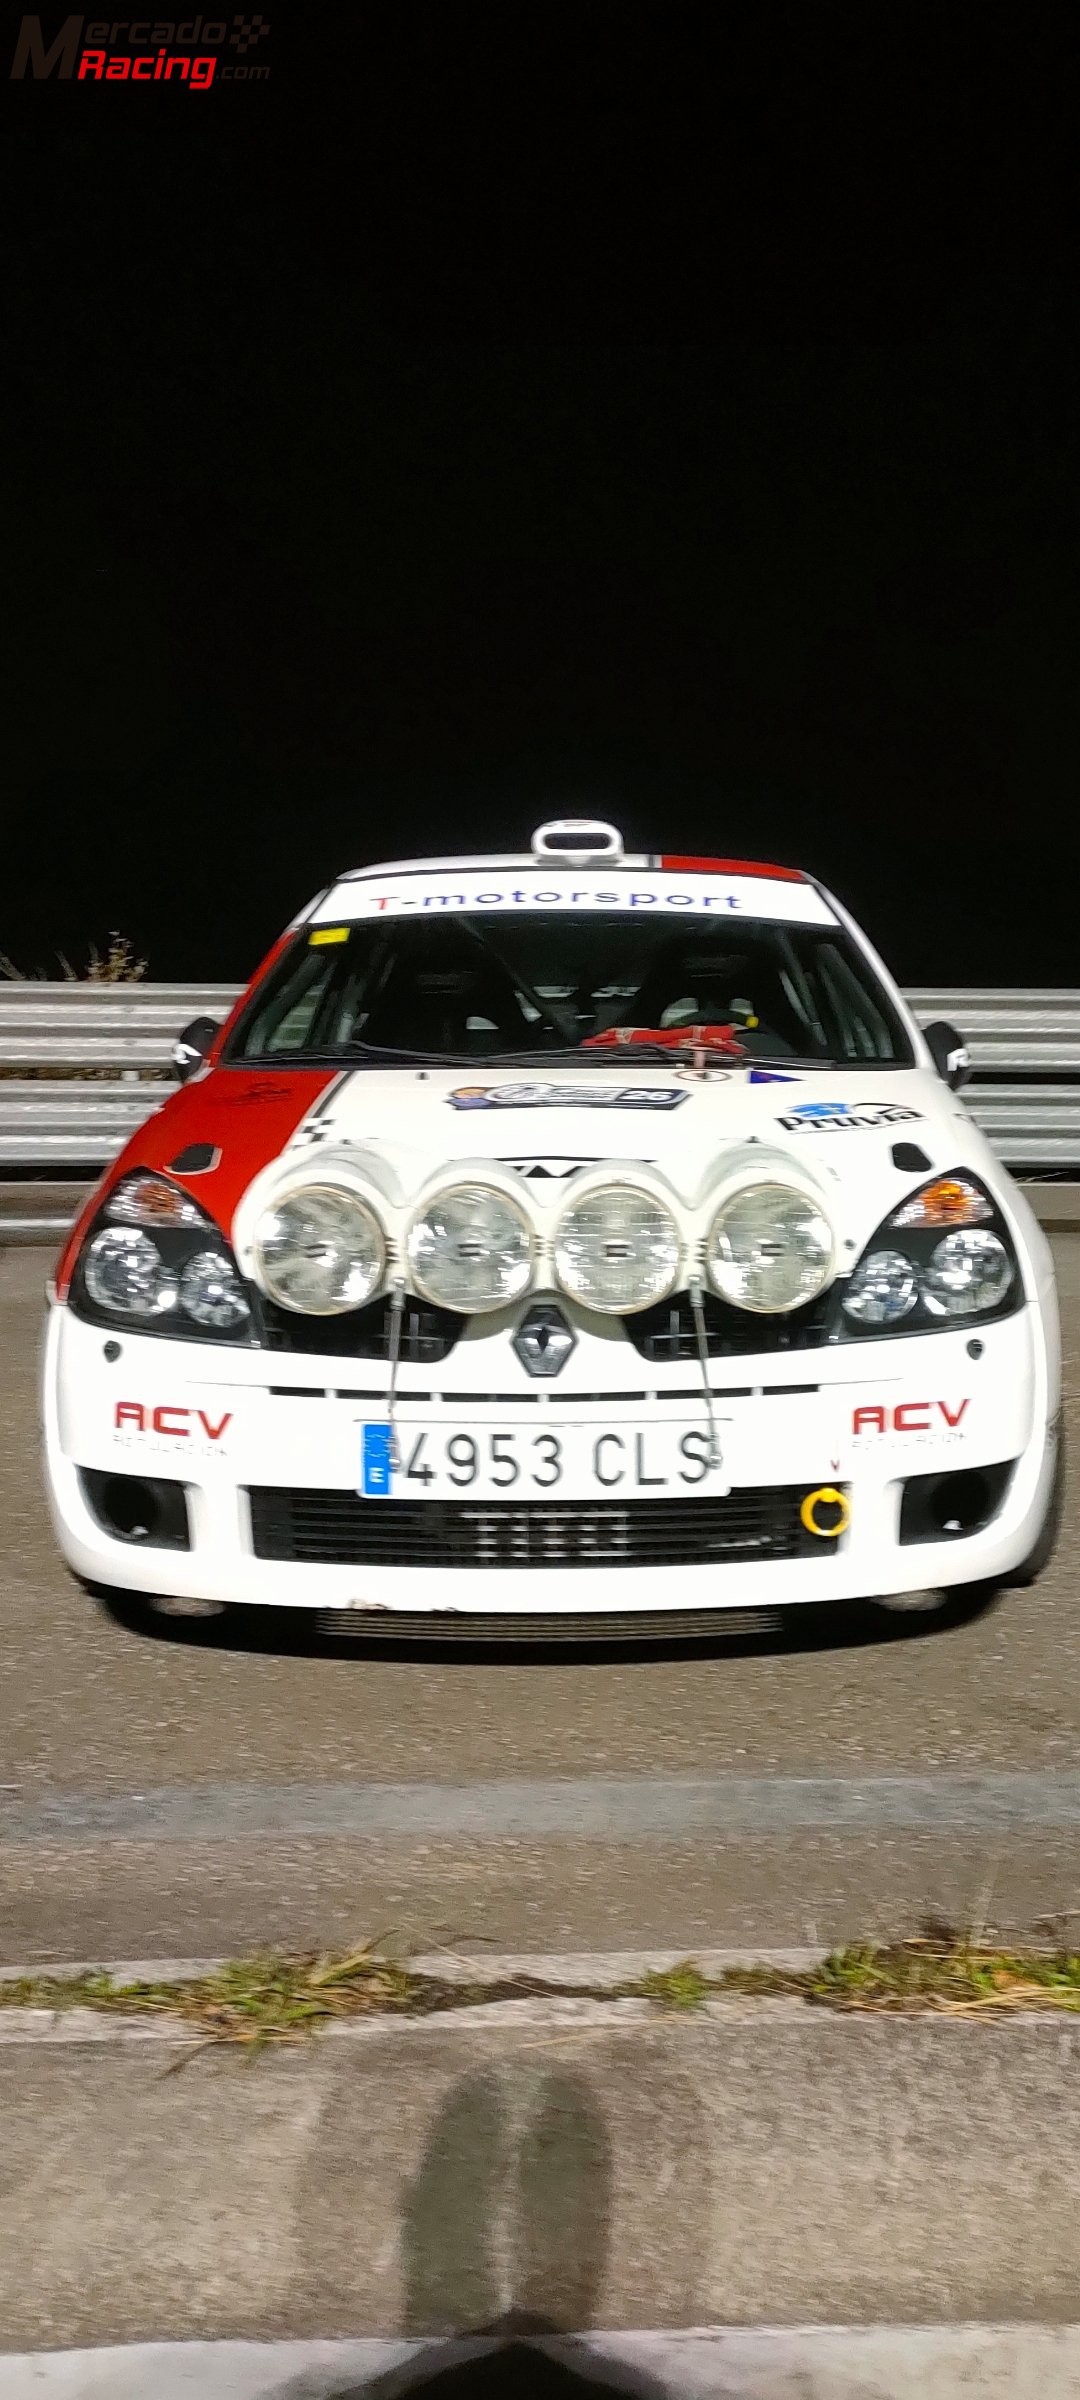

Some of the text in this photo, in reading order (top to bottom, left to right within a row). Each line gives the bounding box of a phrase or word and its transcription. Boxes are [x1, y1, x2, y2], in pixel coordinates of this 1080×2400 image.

[370, 890, 743, 911] T-motorsport
[774, 1110, 926, 1131] Pruvia
[115, 1401, 234, 1440] ACV
[852, 1398, 970, 1435] ACV
[405, 1431, 712, 1487] 4953 CLS
